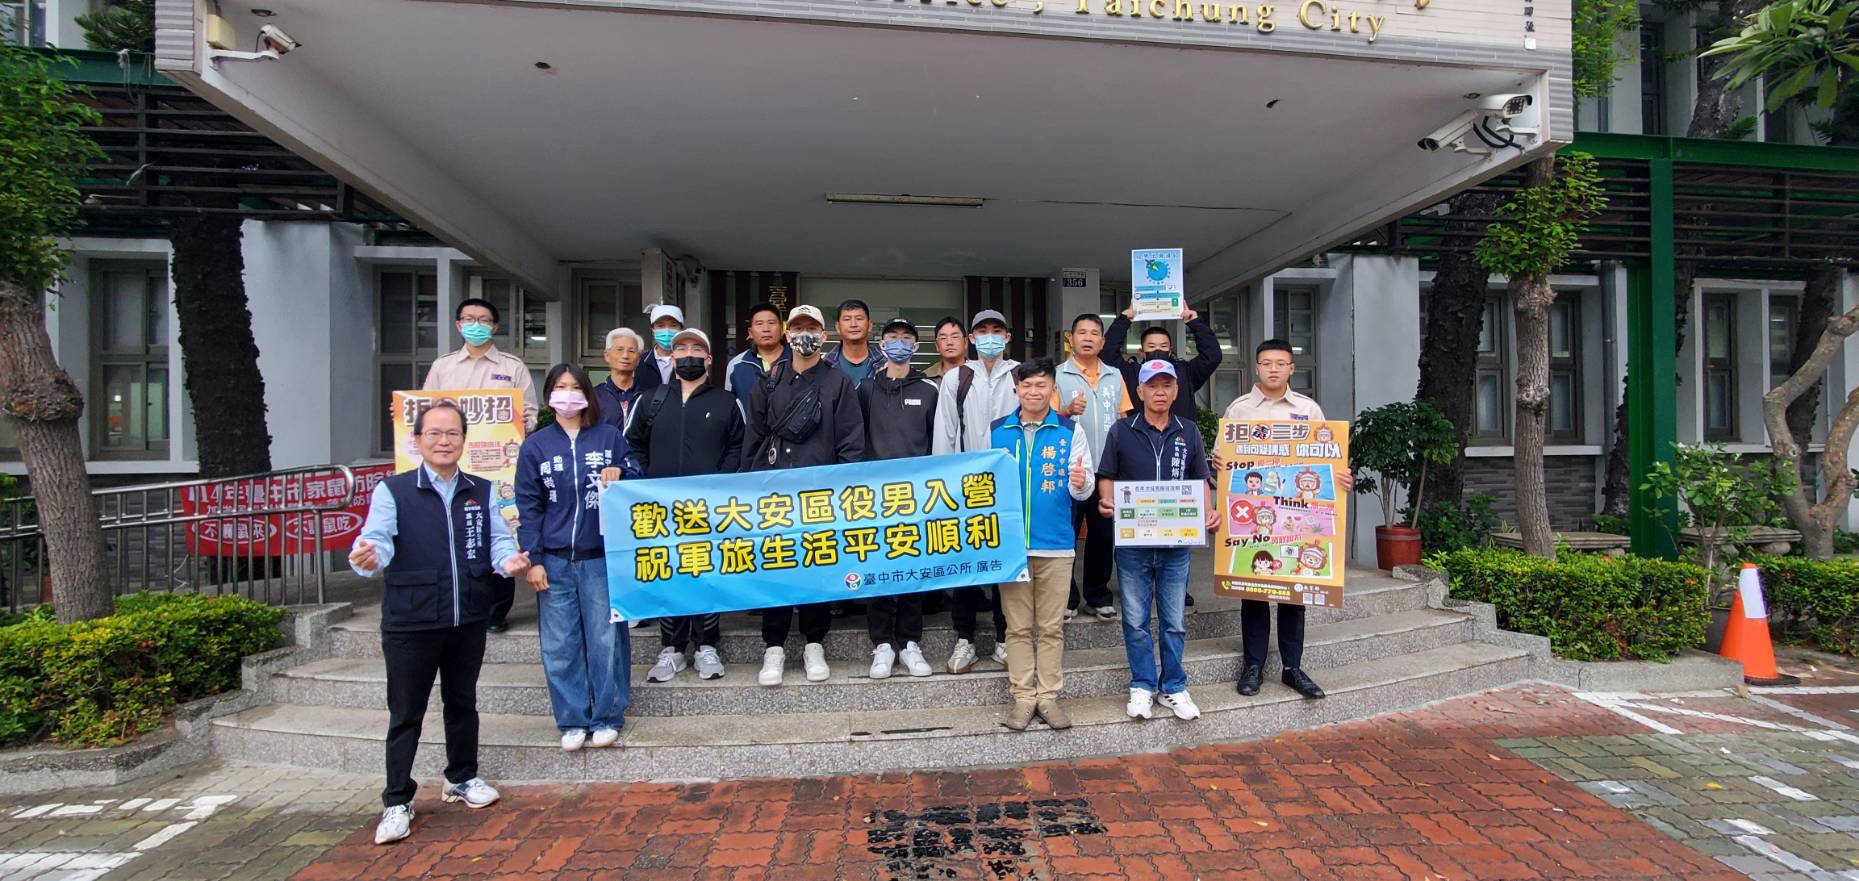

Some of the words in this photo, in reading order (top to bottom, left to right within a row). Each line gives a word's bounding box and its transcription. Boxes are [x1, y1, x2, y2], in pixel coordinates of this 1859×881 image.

[1299, 0, 1384, 43] City
[404, 395, 513, 424] 拒妙招
[1296, 443, 1342, 458] 你可以
[1171, 457, 1181, 480] 陳炳
[1226, 461, 1255, 470] Stop
[585, 451, 604, 509] 李文傑
[630, 472, 995, 539] 歡送大安區役男入營
[1273, 496, 1309, 509] Think
[634, 514, 1000, 582] 祝軍旅生活平安順利
[1225, 537, 1249, 547] Say
[1253, 534, 1271, 544] No
[863, 562, 972, 586] 臺中市大安區公所
[976, 560, 1003, 573] 廣告
